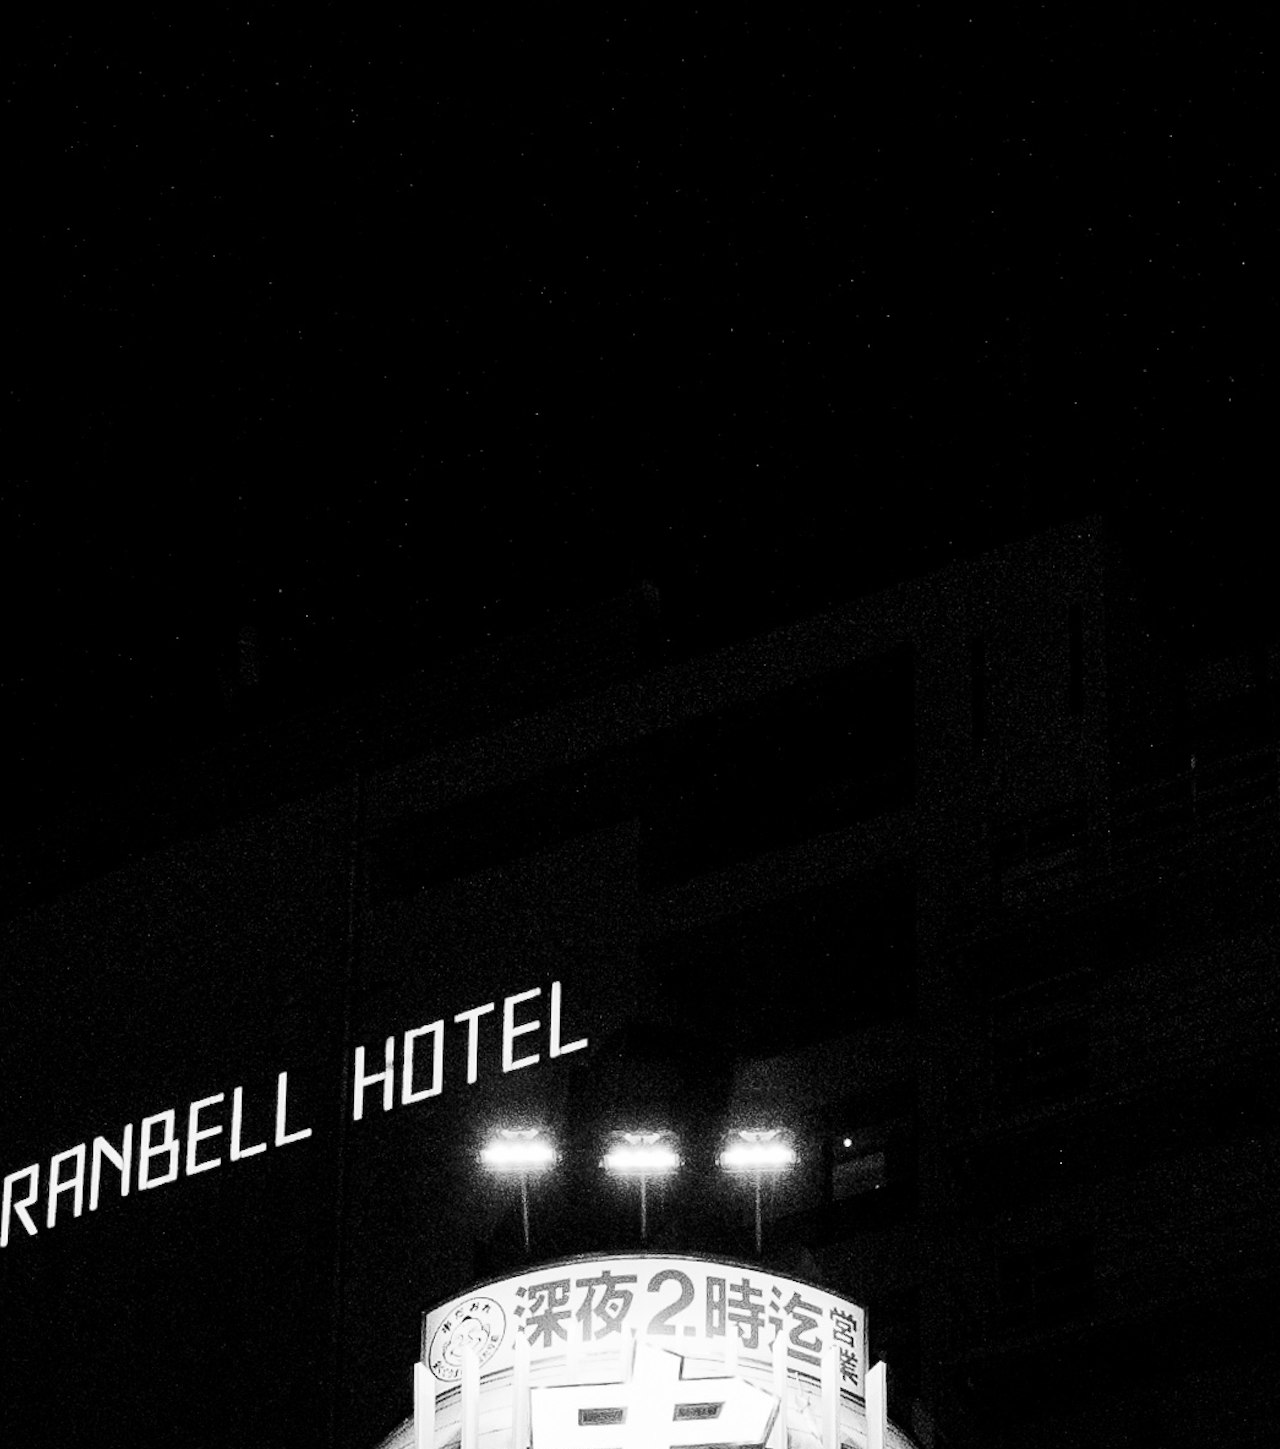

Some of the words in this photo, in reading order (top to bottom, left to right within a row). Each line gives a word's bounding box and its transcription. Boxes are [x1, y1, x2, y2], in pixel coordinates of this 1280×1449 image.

[352, 981, 588, 1122] HOTEL
[513, 1268, 824, 1366] 深夜2時迄
[828, 1307, 859, 1385] 営業
